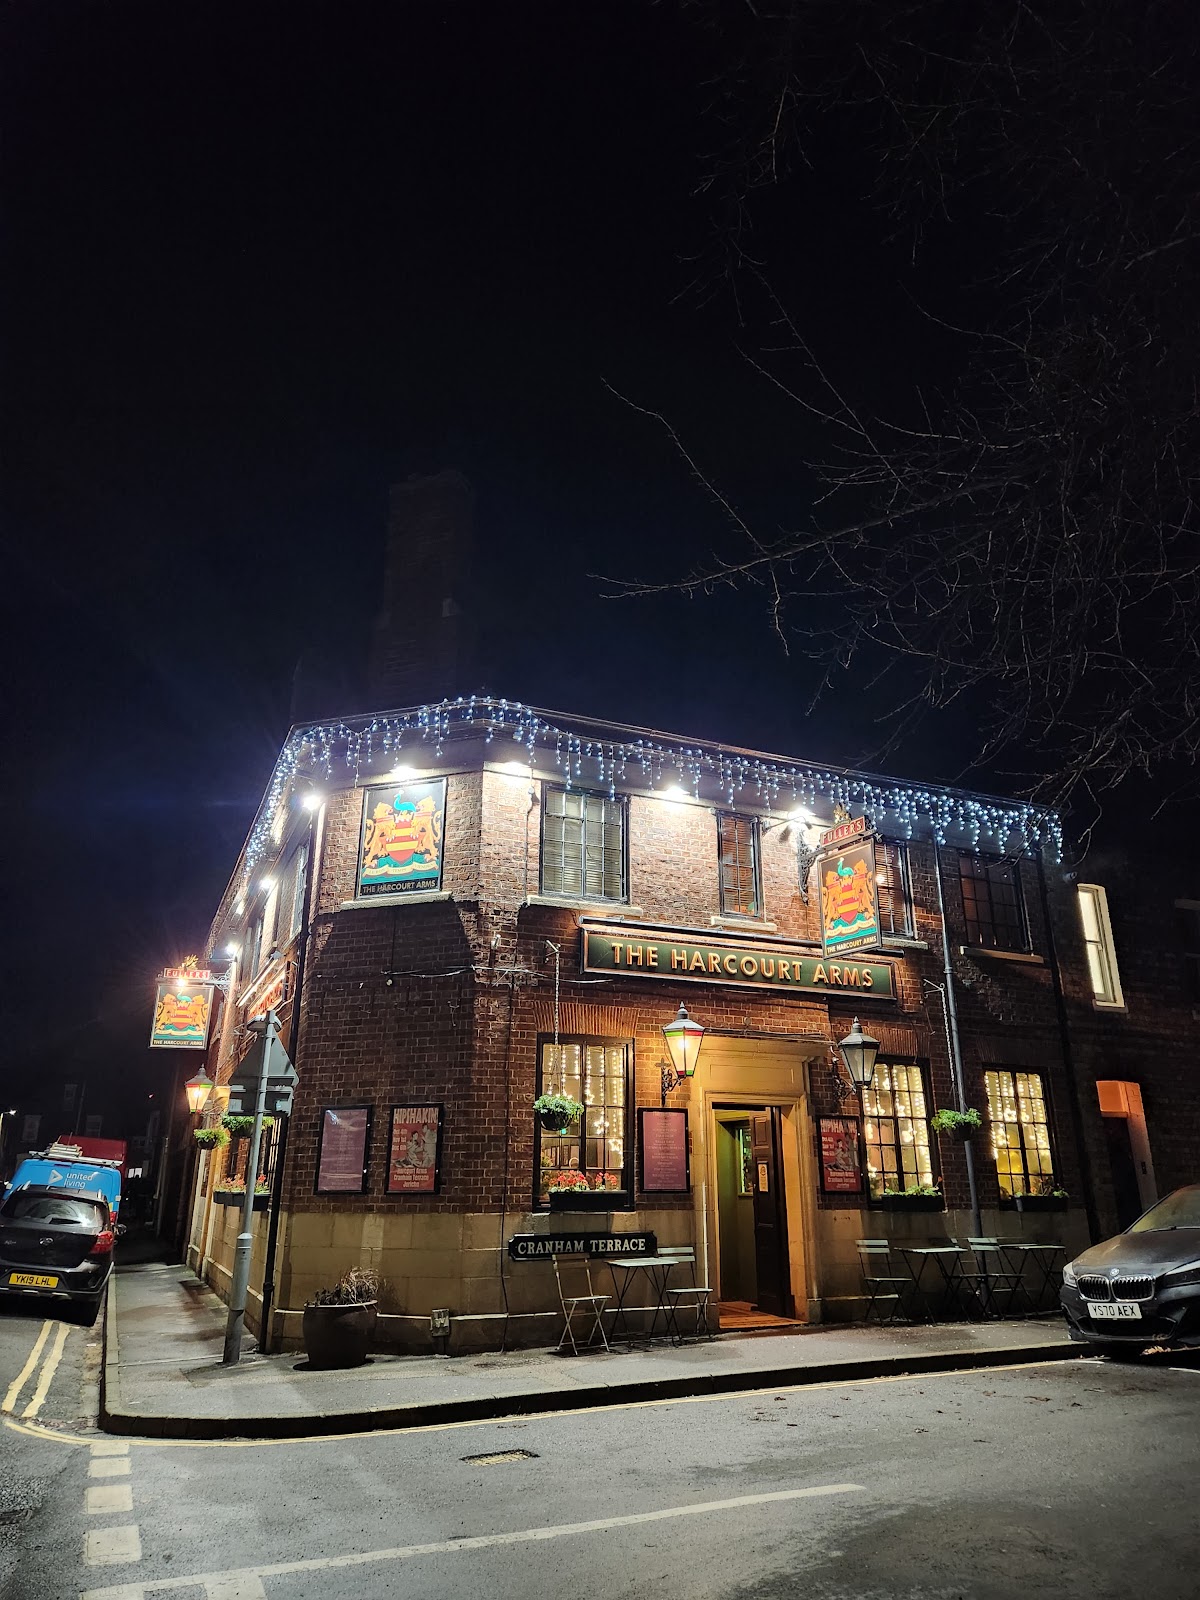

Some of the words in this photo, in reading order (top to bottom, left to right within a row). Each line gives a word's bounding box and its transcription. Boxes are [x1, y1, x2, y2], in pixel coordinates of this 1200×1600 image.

[822, 819, 862, 844] FULLERS
[362, 885, 376, 893] THE
[377, 881, 415, 892] HARCOURT
[416, 879, 436, 889] ARMS
[827, 945, 836, 954] THE
[836, 939, 863, 950] HARCOURT
[862, 935, 877, 945] ARMS
[611, 942, 658, 967] THE
[671, 948, 802, 981] HARCOURT
[813, 963, 874, 987] ARMS
[166, 969, 207, 978] FULLERS
[66, 1172, 95, 1181] united
[64, 1178, 86, 1190] living
[517, 1239, 585, 1255] CRANHAM
[589, 1238, 646, 1252] TERRACE
[15, 1275, 33, 1285] YK19
[35, 1276, 51, 1285] LHL
[1092, 1305, 1115, 1316] YS70
[1118, 1305, 1137, 1316] AEX
